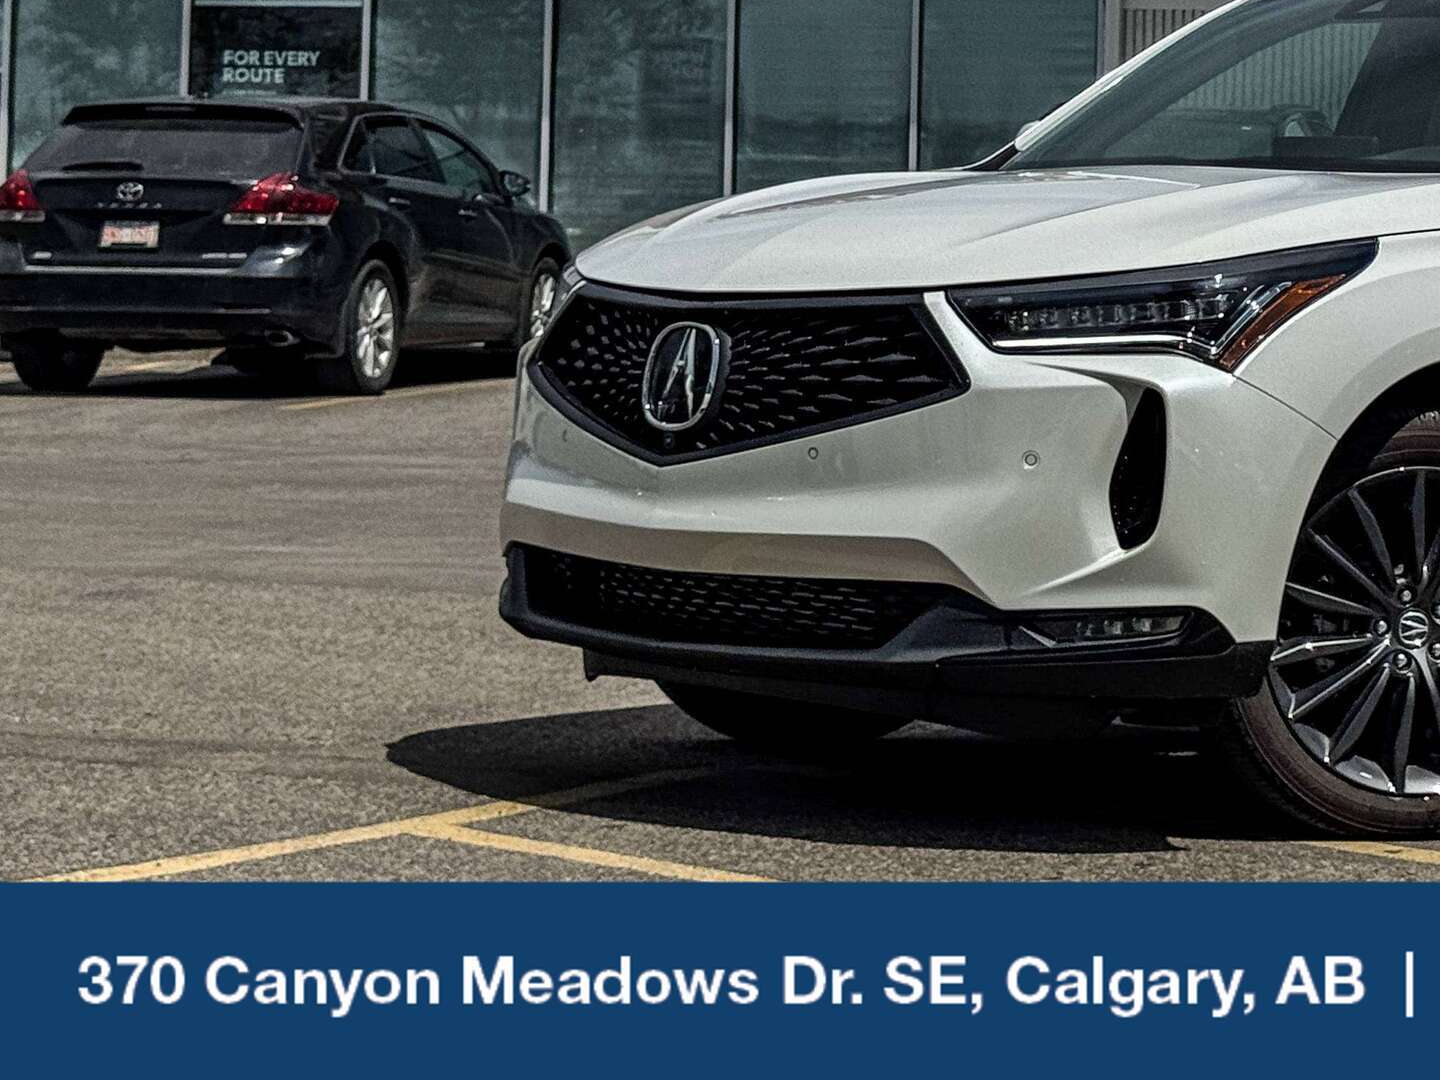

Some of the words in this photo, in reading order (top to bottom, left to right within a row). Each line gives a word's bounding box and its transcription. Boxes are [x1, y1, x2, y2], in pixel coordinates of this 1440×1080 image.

[223, 50, 260, 66] FOR
[264, 50, 320, 66] EVERY
[222, 68, 285, 83] ROUTE
